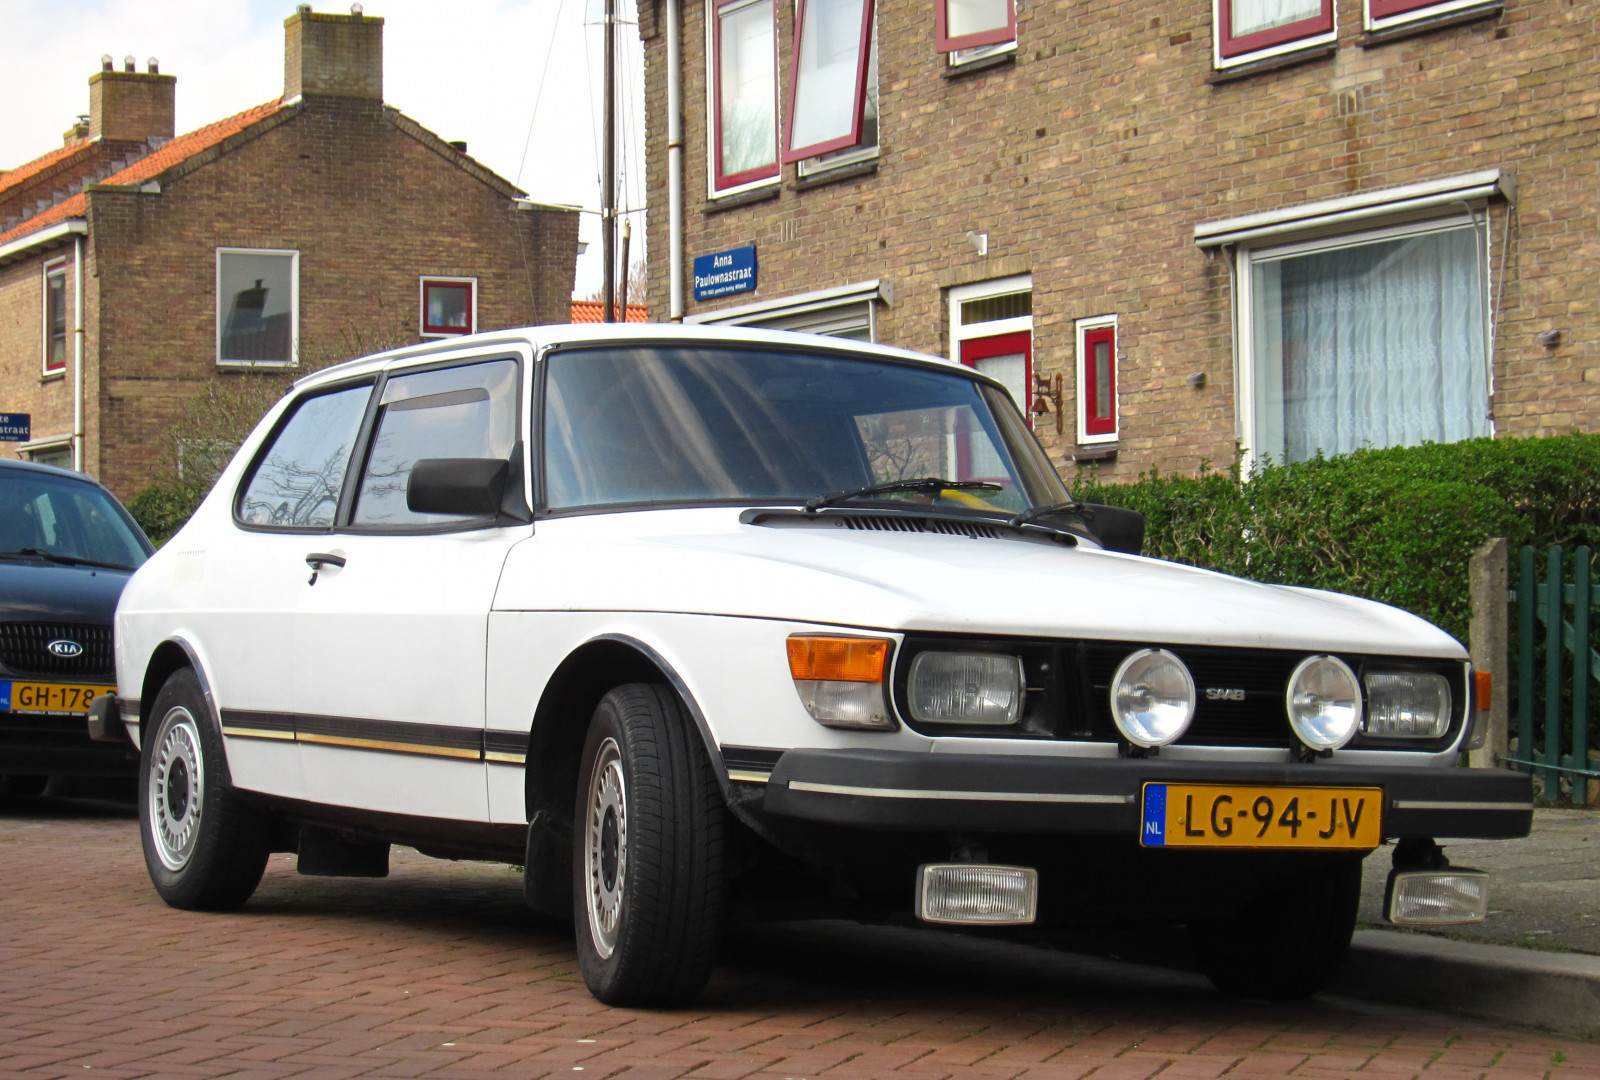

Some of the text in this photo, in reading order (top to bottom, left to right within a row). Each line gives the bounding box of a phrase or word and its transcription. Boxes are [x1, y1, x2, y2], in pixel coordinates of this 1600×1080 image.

[713, 254, 733, 269] Anna
[695, 266, 752, 289] Paulownastraat
[54, 643, 77, 653] KIA
[1206, 687, 1245, 701] SAAB
[1185, 794, 1365, 839] LG-94-JV
[1146, 821, 1162, 835] NL
